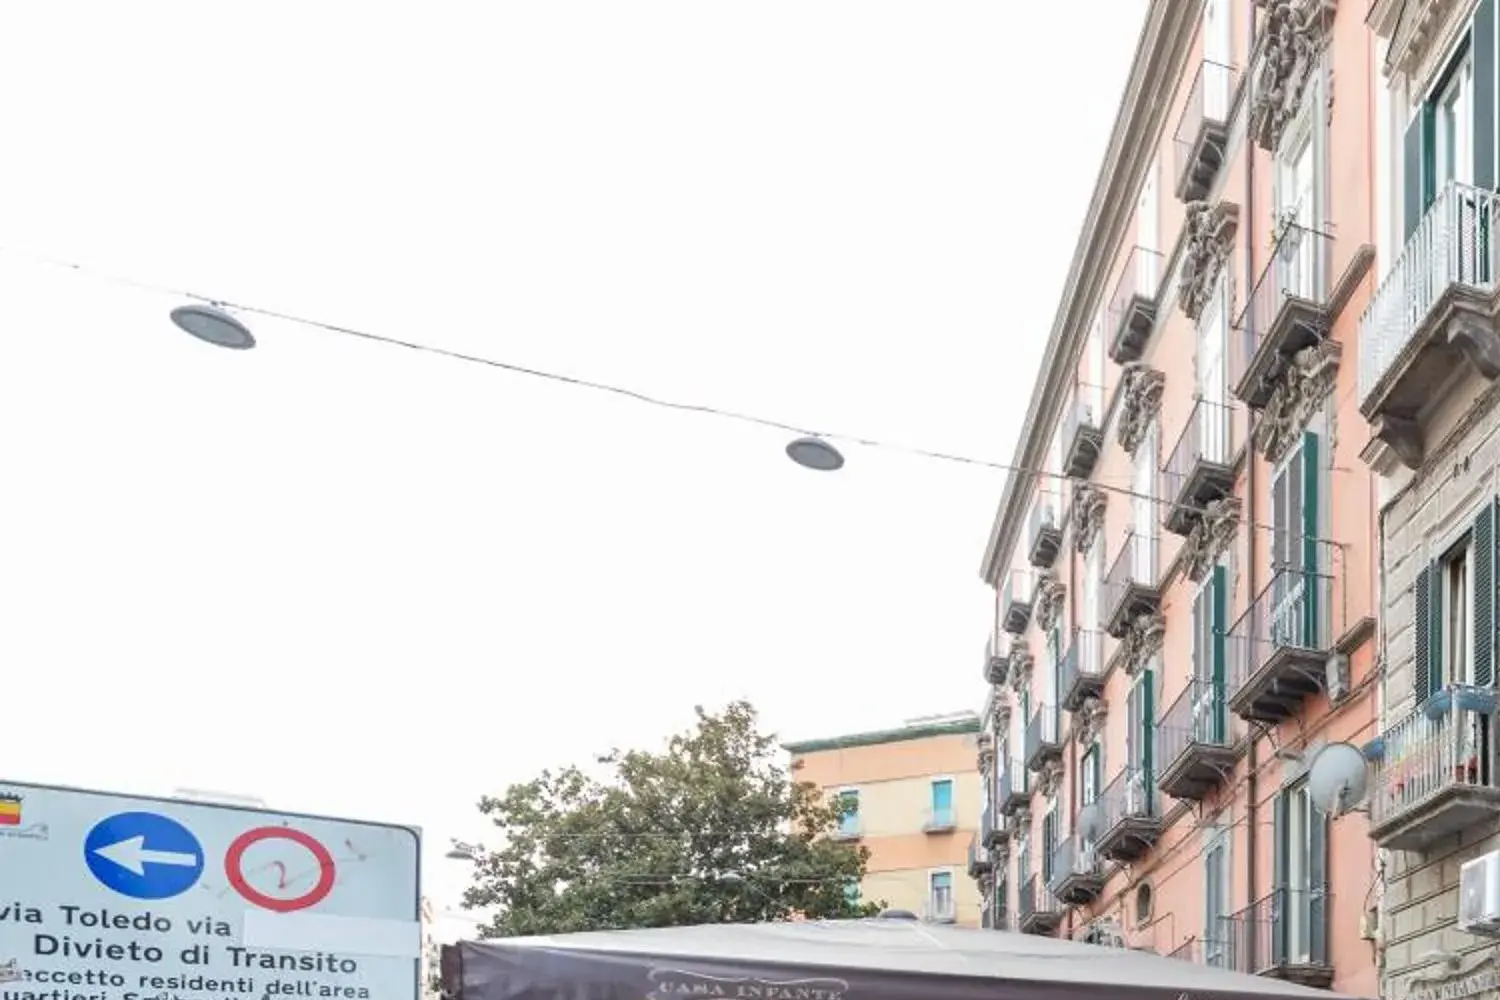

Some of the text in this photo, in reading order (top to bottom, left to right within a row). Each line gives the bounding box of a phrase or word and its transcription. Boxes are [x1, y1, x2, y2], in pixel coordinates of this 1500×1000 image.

[0, 902, 231, 937] via Toledo via
[34, 934, 357, 974] Divieto di Transito
[139, 975, 253, 993] residenti
[265, 979, 370, 999] dell'area
